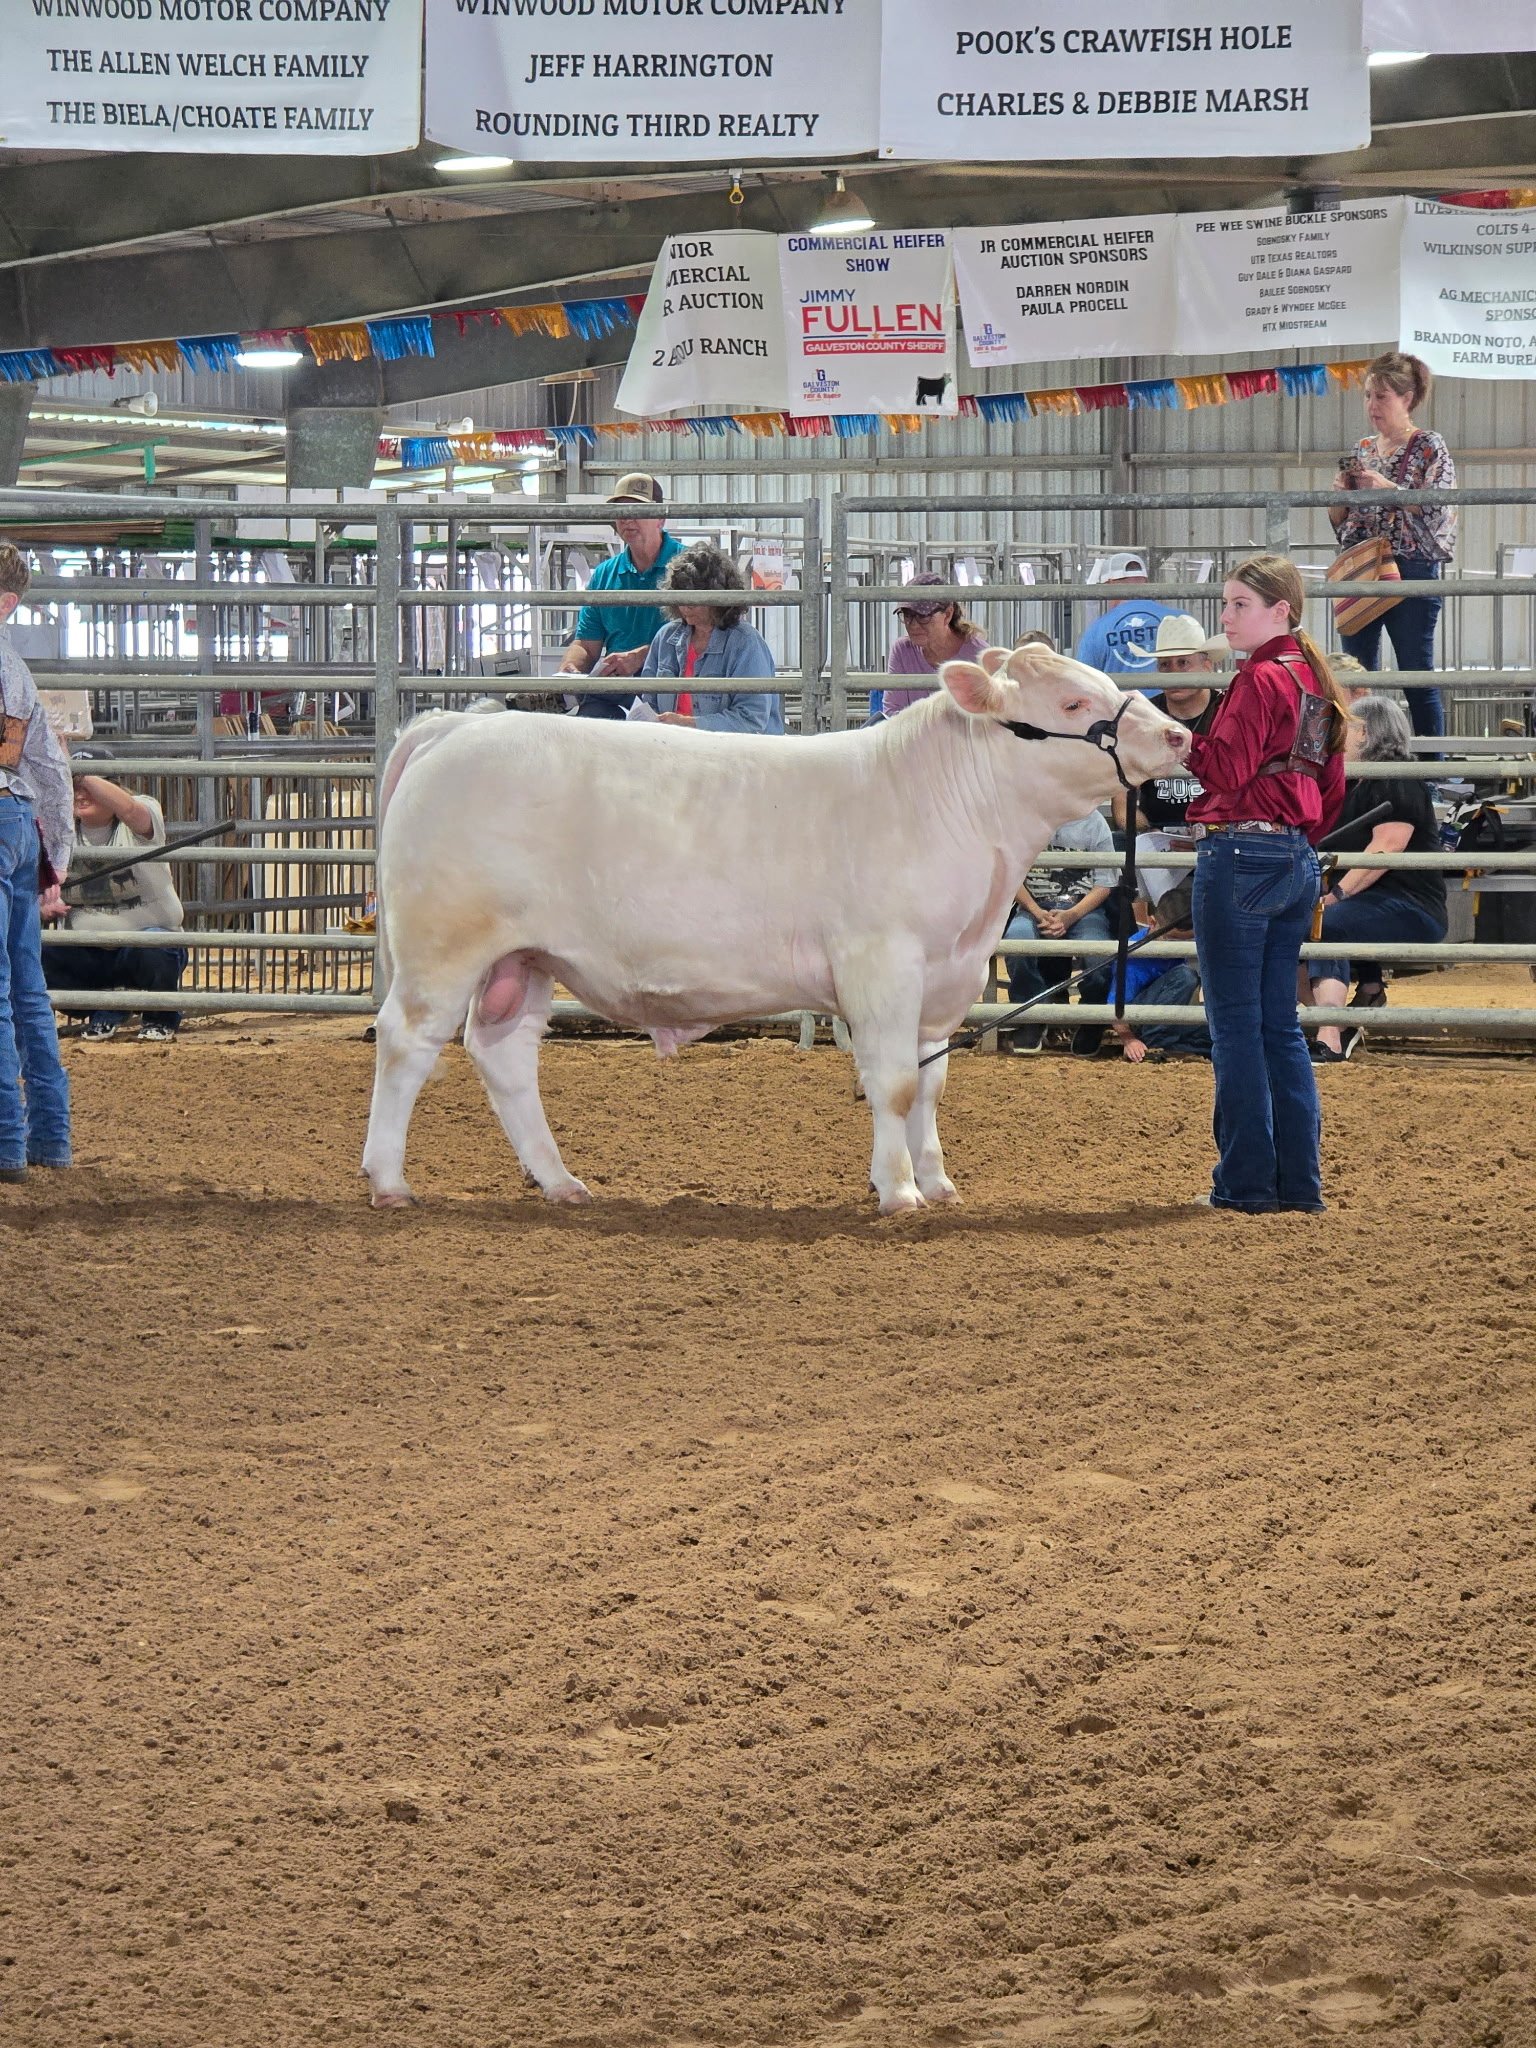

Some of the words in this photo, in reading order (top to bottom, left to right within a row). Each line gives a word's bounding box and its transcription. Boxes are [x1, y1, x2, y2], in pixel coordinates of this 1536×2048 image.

[33, 0, 153, 21] WINWOOD
[160, 0, 253, 21] MOTOR
[259, 0, 390, 22] COMPANY
[456, 0, 594, 16] WINWOOD
[603, 0, 703, 16] MOTOR
[710, 0, 845, 16] COMPANY
[955, 27, 1055, 55] POOK'S
[1063, 27, 1213, 53] CRAWFISH
[1220, 25, 1293, 50] HOLE
[46, 48, 92, 73] THE
[99, 51, 171, 76] ALLEN
[176, 53, 267, 77] WELCH
[274, 54, 370, 79] FAMILY
[525, 54, 585, 83] JEFF
[593, 53, 774, 78] HARRINGTON
[937, 91, 1065, 117] CHARLES
[1071, 92, 1091, 115] &
[1097, 90, 1198, 116] DEBBIE
[1205, 87, 1310, 114] MARSH
[46, 101, 97, 125] THE
[102, 104, 278, 133] BIELA/CHOATE
[284, 107, 375, 131] FAMILY
[475, 109, 619, 137] ROUNDING
[627, 114, 711, 138] THIRD
[718, 114, 820, 138] REALTY
[1196, 222, 1216, 233] PEE
[1219, 220, 1243, 232] WEE
[1246, 216, 1283, 230] SWINE
[1285, 212, 1328, 226] BUCKLE
[1330, 208, 1389, 224] SPONSORS
[1476, 223, 1519, 236] COLTS
[788, 235, 889, 252] COMMERCIAL
[893, 233, 946, 250] HEIFER
[979, 239, 996, 254] JR
[1001, 234, 1099, 252] COMMERCIAL
[1103, 229, 1155, 246] HEIFER
[1423, 241, 1503, 256] WILKINSON
[845, 257, 891, 273] SHOW
[1000, 252, 1065, 270] AUCTION
[1070, 248, 1148, 265] SPONSORS
[799, 288, 856, 304] JIMMY
[1016, 282, 1072, 300] DARREN
[1076, 279, 1130, 296] NORDIN
[1439, 288, 1458, 300] AG
[1460, 289, 1536, 303] MECHANIC
[678, 292, 764, 312] AUCTION
[1021, 301, 1065, 317] PAULA
[1069, 297, 1129, 314] PROCELL
[801, 303, 943, 334] FULLEN
[805, 342, 865, 353] GALVESTON
[866, 341, 906, 352] COUNTY
[907, 341, 945, 351] SHERIFF
[1414, 330, 1482, 346] BRANDON
[1485, 336, 1526, 350] NOTO,
[652, 349, 666, 367] 2
[699, 337, 769, 357] RANCH
[1452, 351, 1494, 364] FARM
